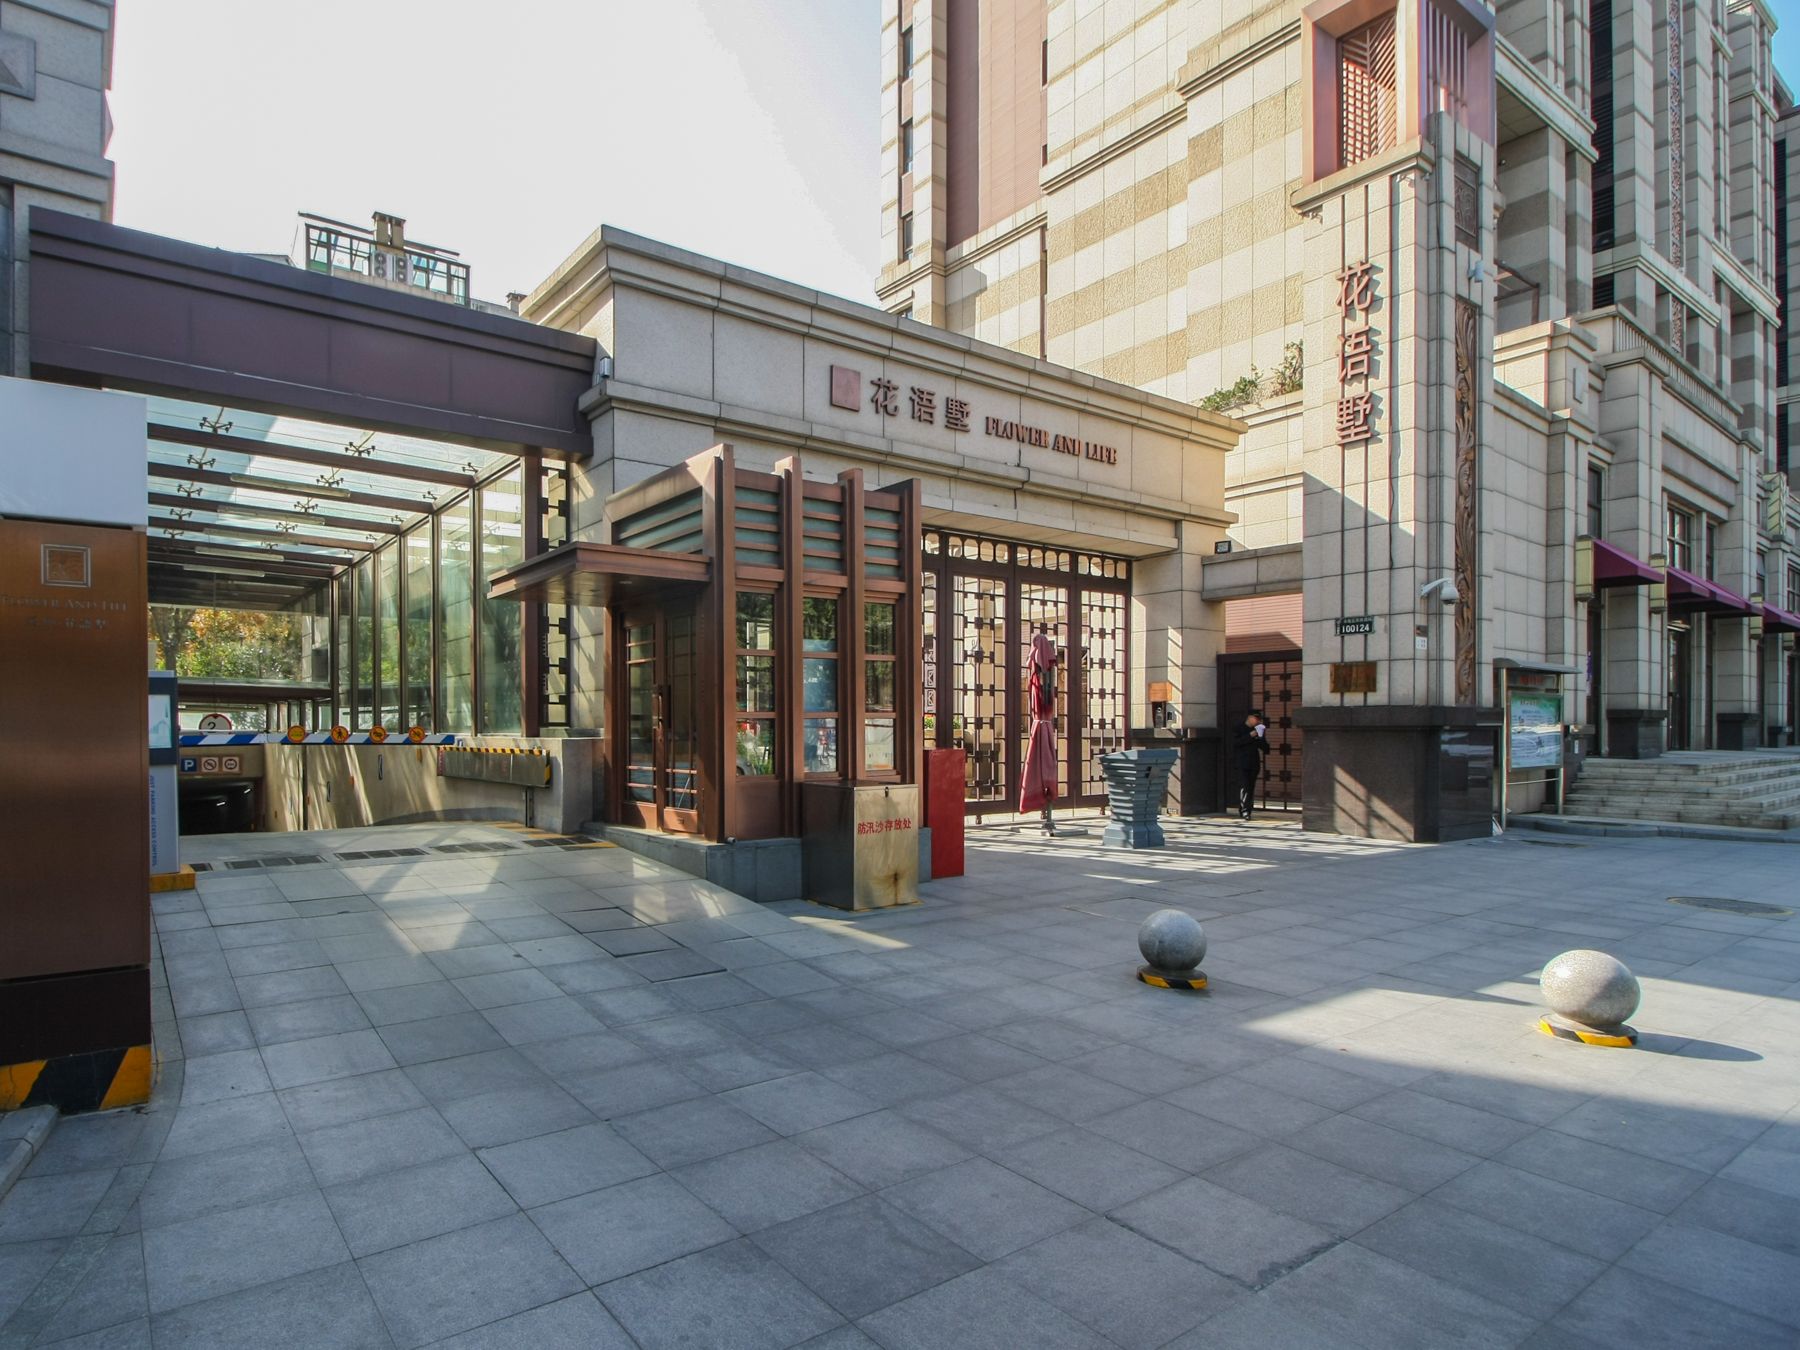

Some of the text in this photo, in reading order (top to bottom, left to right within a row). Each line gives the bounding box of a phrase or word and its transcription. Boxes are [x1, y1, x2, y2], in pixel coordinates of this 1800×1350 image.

[1336, 261, 1373, 445] 花语墅
[870, 377, 971, 433] 花语墅
[985, 416, 1117, 465] FLOWER AND LIFE
[1342, 623, 1369, 633] 100124
[184, 759, 194, 771] P
[857, 817, 912, 835] 防汛沙存放处
